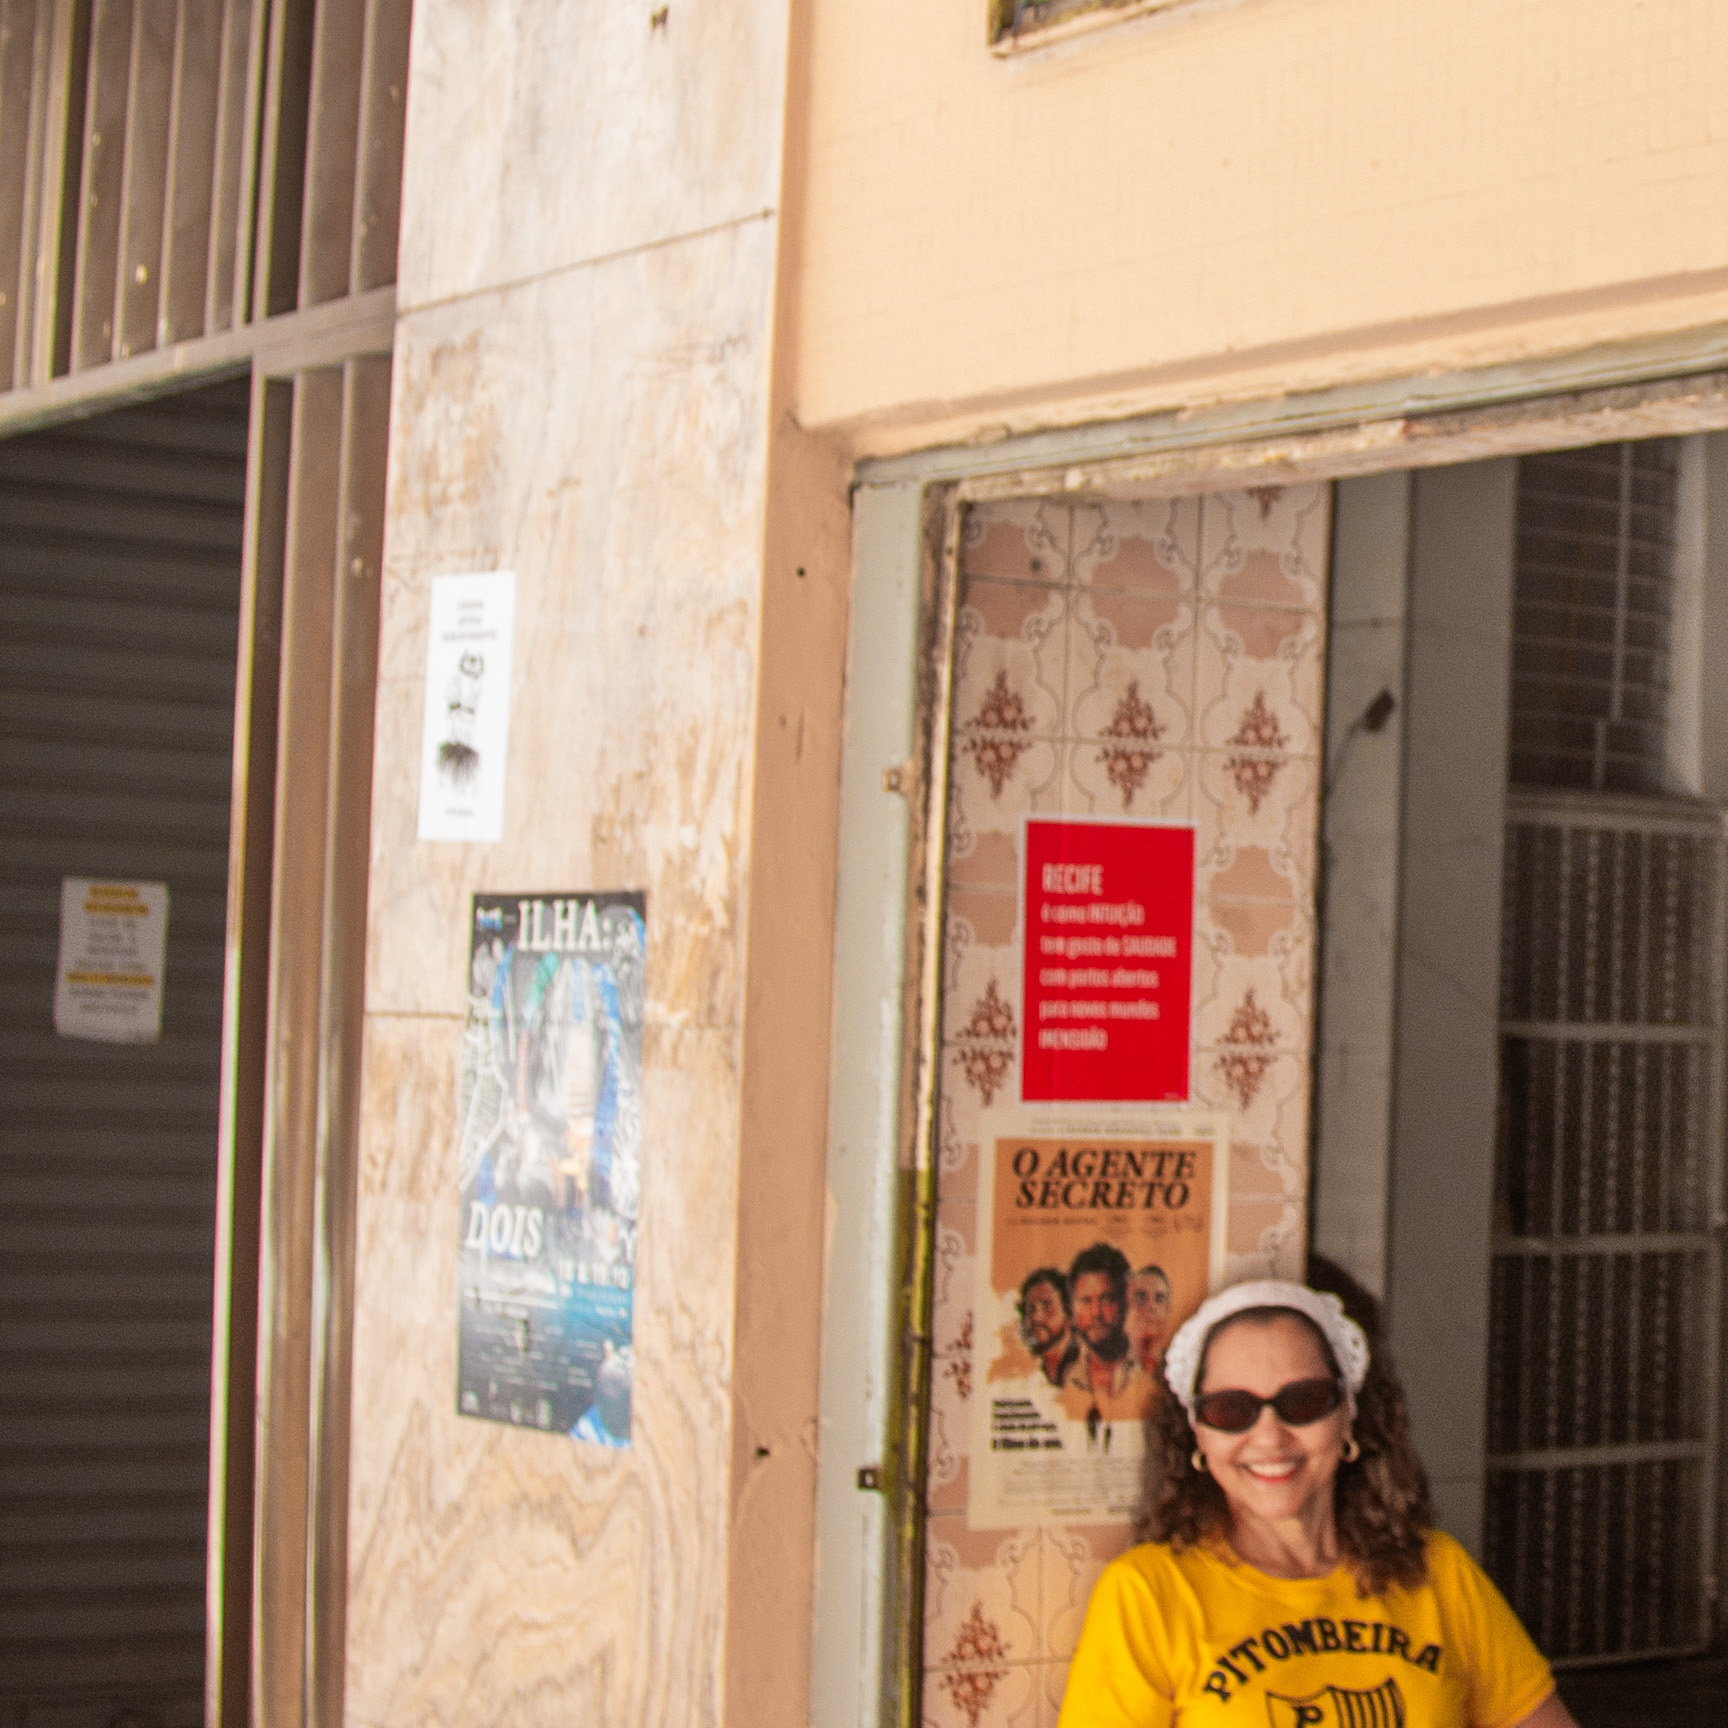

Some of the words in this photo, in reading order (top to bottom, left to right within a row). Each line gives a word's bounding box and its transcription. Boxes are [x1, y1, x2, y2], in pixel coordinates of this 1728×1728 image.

[1042, 862, 1104, 896] RECIFE
[516, 898, 612, 952] ILHA:
[1088, 899, 1146, 928] INTUIÇÃO
[1121, 935, 1177, 958] SAUDADE
[1012, 1147, 1040, 1178] O
[1045, 1148, 1197, 1179] AGENTE
[1015, 1179, 1190, 1210] SECRETO
[465, 1200, 544, 1258] DOIS
[1202, 1617, 1443, 1703] PITOMBEIRA
